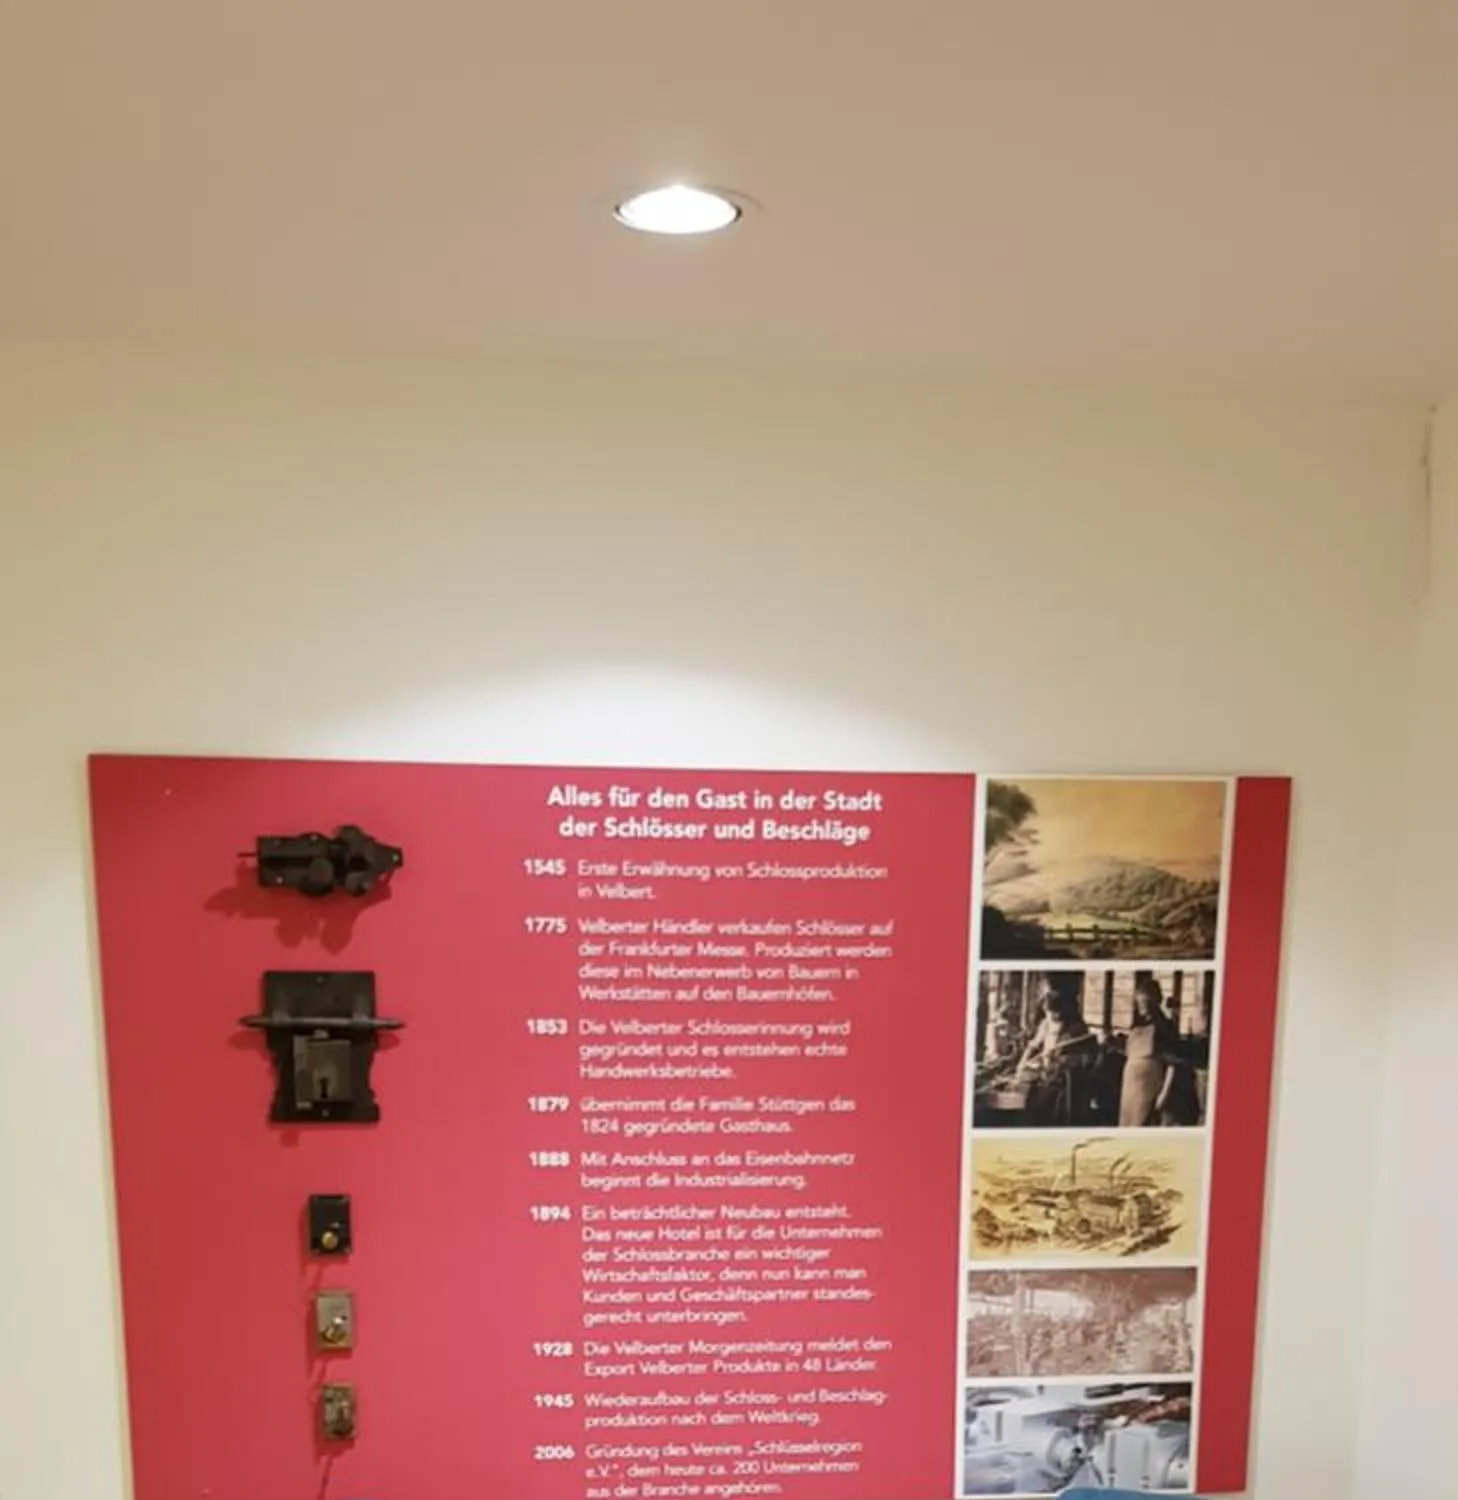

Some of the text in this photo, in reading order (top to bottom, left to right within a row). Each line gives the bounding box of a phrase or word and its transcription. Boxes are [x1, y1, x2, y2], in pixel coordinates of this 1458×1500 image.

[547, 784, 881, 812] Alles für den Gast in der Stadt
[559, 815, 870, 845] der Schlösser und Beschläge
[522, 858, 887, 882] 1545 Erste Erwähnung von Schlossproduktion
[578, 881, 656, 900] in Velbert.
[523, 916, 892, 936] 1775 Velberter Händler verkaufen Schlösser auf
[578, 939, 604, 957] der
[608, 940, 692, 957] Frankfurter
[754, 941, 832, 958] Produziert
[835, 942, 892, 958] werden
[579, 962, 859, 980] diese im Nebenerwerb von Bauern in
[578, 984, 671, 1001] Werkstätten
[675, 984, 698, 1001] auf
[702, 986, 731, 1001] den
[525, 1017, 850, 1040] 1853 Die Velberter Schlosserinnung wird
[579, 1041, 846, 1062] gegründet und es entstehen echte
[578, 1062, 737, 1079] Handwerksbetriebe.
[526, 1095, 571, 1113] 1879
[580, 1096, 666, 1113] übernimmt
[669, 1096, 695, 1112] die
[698, 1096, 754, 1112] Familie
[828, 1096, 856, 1112] das
[581, 1117, 793, 1138] 1824 gegründete Gasthaus.
[580, 1151, 606, 1167] Mit
[611, 1151, 687, 1167] Anschluss
[691, 1154, 710, 1166] an
[714, 1151, 741, 1166] das
[580, 1171, 807, 1192] beginnt die Industrialisierung.
[528, 1203, 851, 1221] 1894 Ein beträchtlicher Neubau entsteht.
[581, 1224, 880, 1242] Das neue Hotel ist für die Unternehmen
[582, 1245, 829, 1264] der Schlossbranche ein wichtiger
[718, 1266, 757, 1282] denn
[762, 1269, 790, 1281] nun
[794, 1265, 830, 1280] kann
[834, 1268, 865, 1280] man
[582, 1288, 642, 1304] Kunden
[646, 1288, 676, 1303] und
[679, 1285, 807, 1304] Geschäftspartner
[582, 1307, 747, 1328] gerecht unterbringen.
[532, 1336, 890, 1358] 1928 Die Velberter Morgenzeitung meldet den
[584, 1360, 635, 1378] Export
[639, 1359, 708, 1375] Velberter
[712, 1356, 781, 1374] Produkte
[784, 1358, 799, 1373] in
[802, 1357, 822, 1372] 48
[532, 1393, 575, 1408] 1945
[584, 1390, 691, 1408] Wiederaufbau
[693, 1390, 719, 1406] der
[786, 1389, 816, 1404] und
[584, 1412, 668, 1430] produktion
[670, 1411, 706, 1426] nach
[710, 1410, 743, 1425] dem
[532, 1445, 576, 1460] 2006
[586, 1443, 659, 1462] Gründung
[662, 1442, 688, 1457] des
[627, 1462, 660, 1477] dem
[664, 1461, 704, 1476] heute
[731, 1459, 761, 1475] 200
[763, 1458, 860, 1475] Unternehmen
[586, 1480, 781, 1499] aus der Branche angehören.
